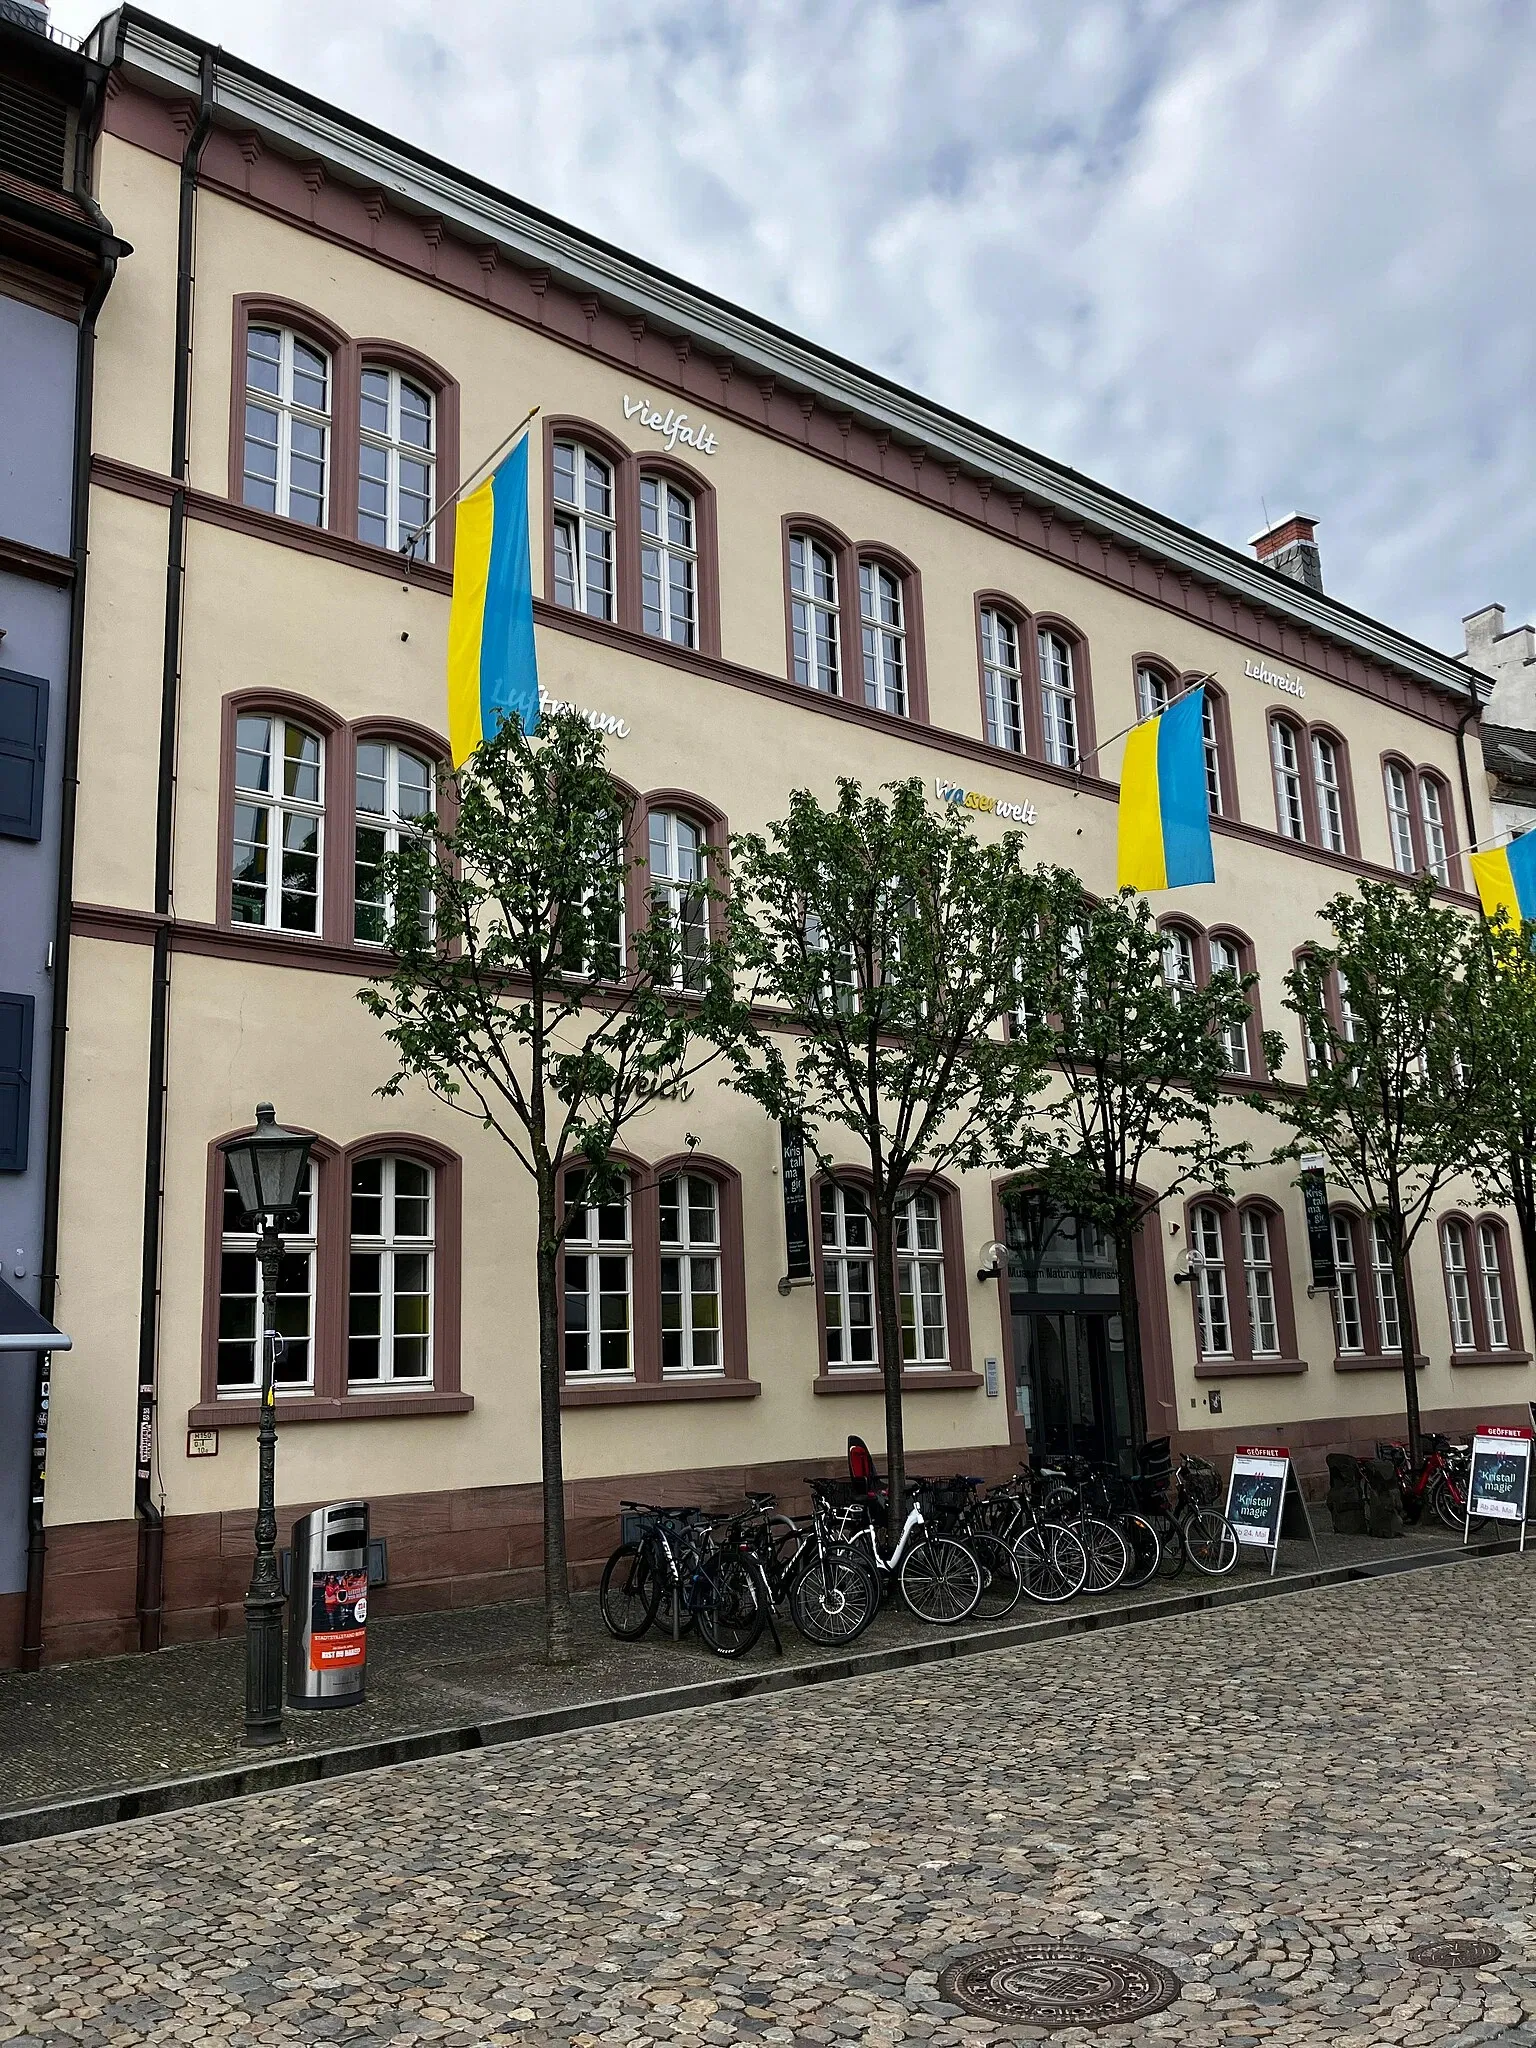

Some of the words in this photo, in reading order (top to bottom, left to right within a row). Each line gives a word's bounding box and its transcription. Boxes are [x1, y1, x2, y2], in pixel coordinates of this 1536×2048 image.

[623, 394, 719, 455] Vielfalt
[1244, 659, 1306, 698] Lehrreich
[935, 776, 1038, 826] Wasserwelt
[784, 1146, 801, 1158] Kris
[790, 1155, 804, 1168] tall
[785, 1169, 798, 1179] ma
[1306, 1188, 1323, 1198] Kris
[1312, 1196, 1326, 1206] tall
[1308, 1206, 1321, 1214] ma
[1488, 1428, 1521, 1436] GEÖFFNET
[1246, 1447, 1279, 1457] GEÖFFNET
[1482, 1471, 1516, 1482] Kristall
[1484, 1481, 1513, 1494] magie
[1239, 1494, 1272, 1507] Kristall
[1240, 1506, 1268, 1519] magie
